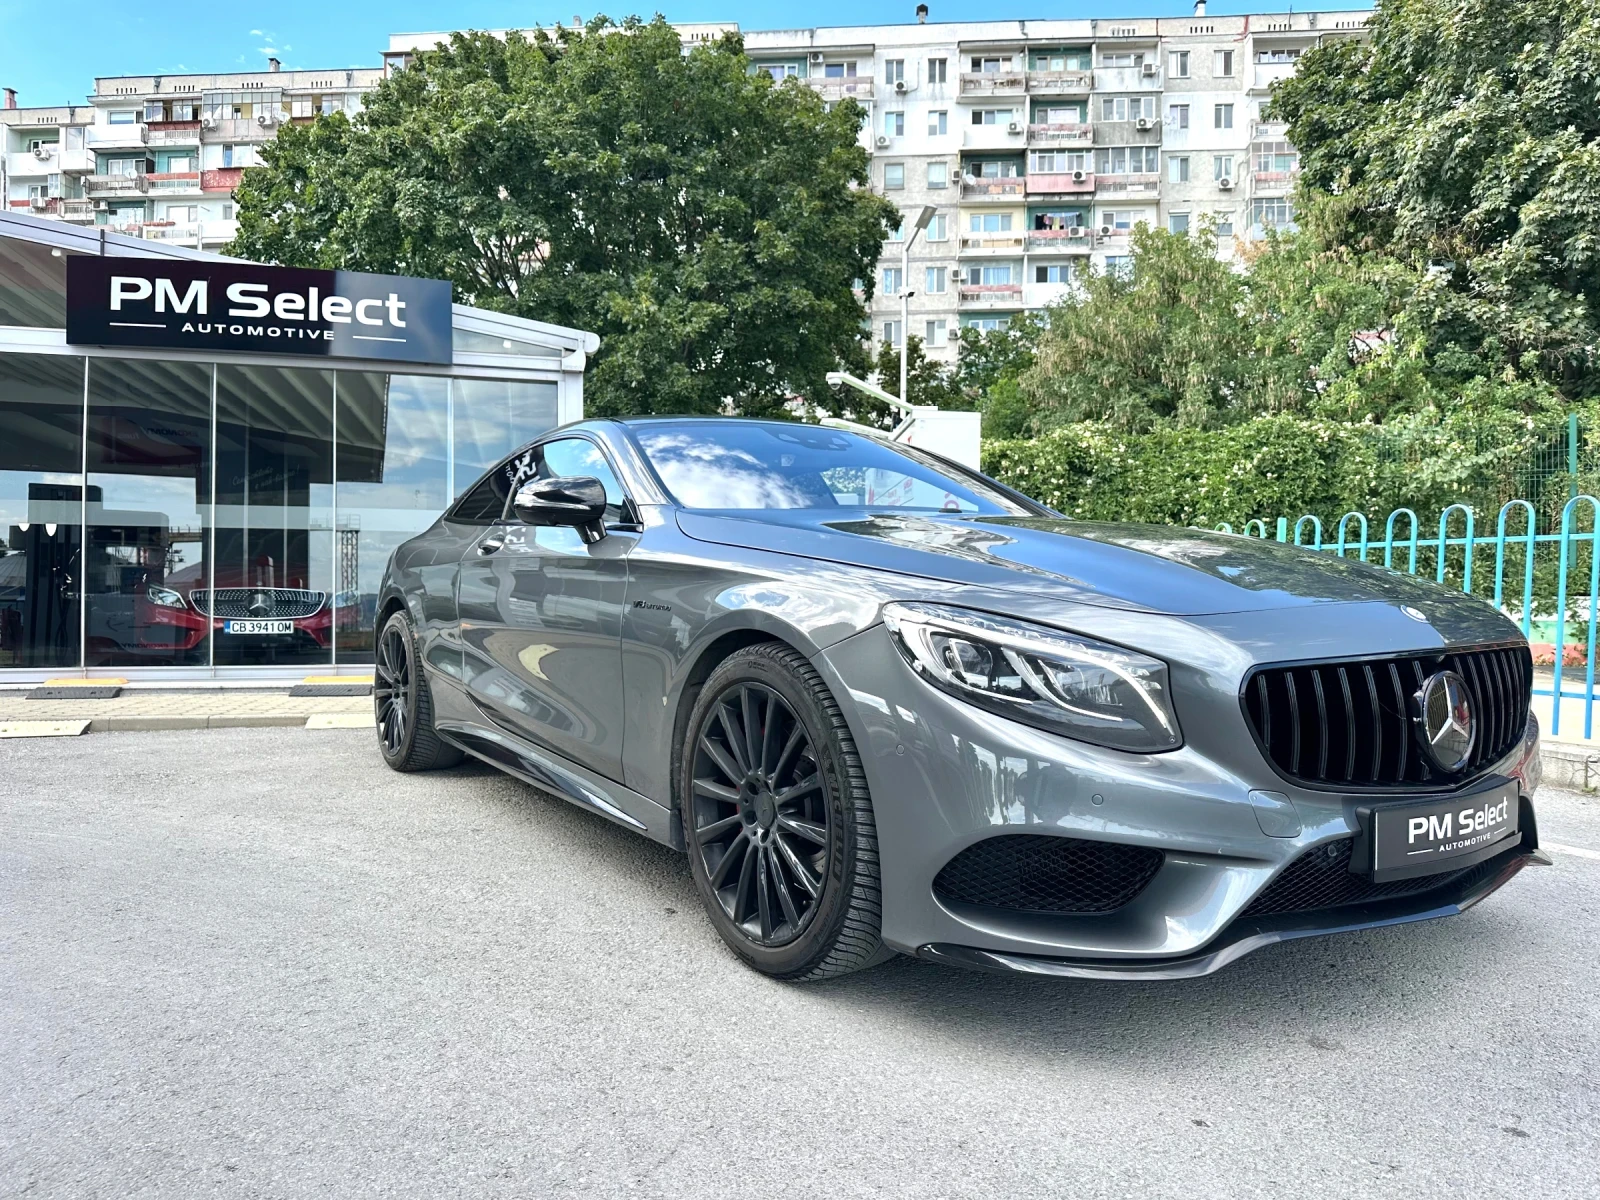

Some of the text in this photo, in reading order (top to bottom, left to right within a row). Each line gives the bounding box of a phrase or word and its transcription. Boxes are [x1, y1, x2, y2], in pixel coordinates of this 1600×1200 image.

[110, 276, 407, 328] PM Select
[181, 322, 335, 340] AUTOMOTIVE
[231, 622, 292, 633] CB 3941 OM
[827, 772, 843, 876] MICHELIN
[1408, 796, 1508, 844] PM Select
[1438, 832, 1491, 853] AUTOMOTIVE
